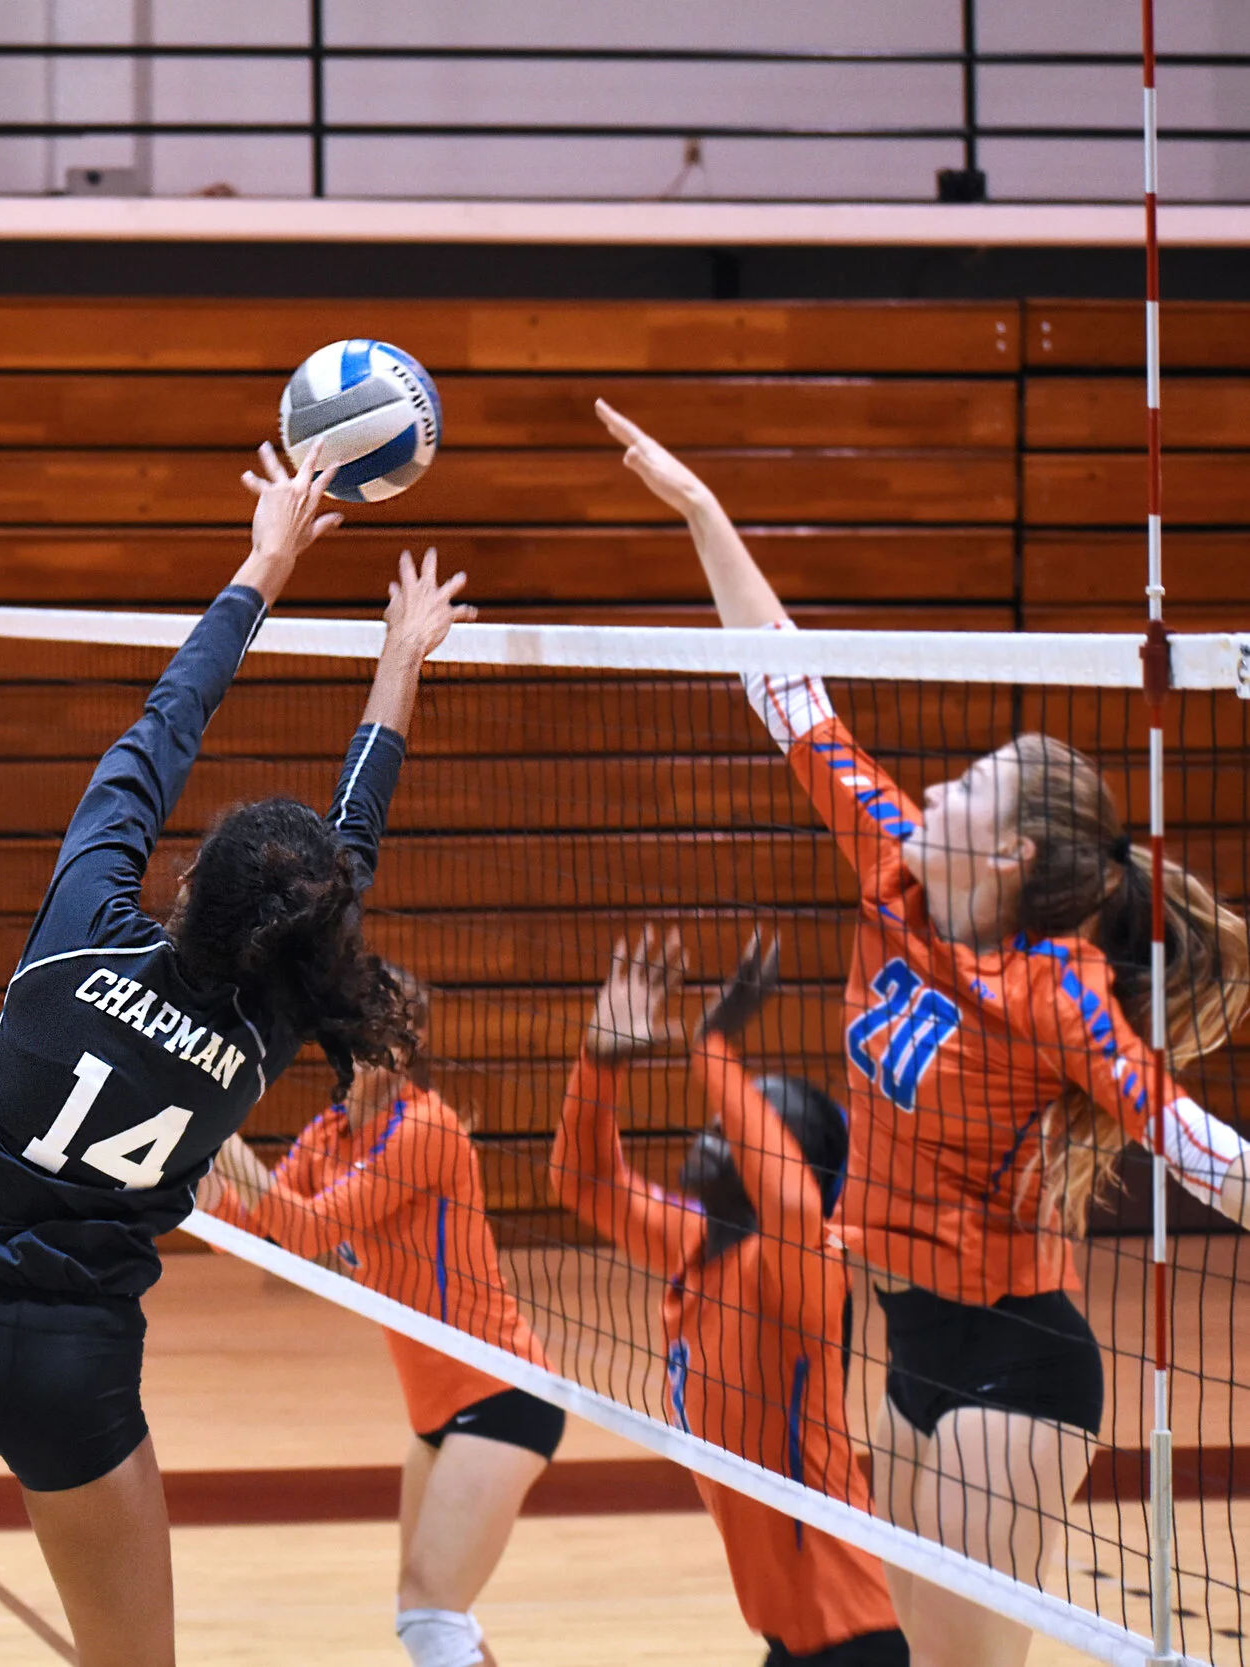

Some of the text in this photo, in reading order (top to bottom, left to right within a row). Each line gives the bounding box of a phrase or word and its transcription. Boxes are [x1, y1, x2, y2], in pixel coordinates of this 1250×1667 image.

[75, 968, 246, 1090] CHAPMAN
[846, 957, 963, 1113] 20
[21, 1051, 194, 1191] 14
